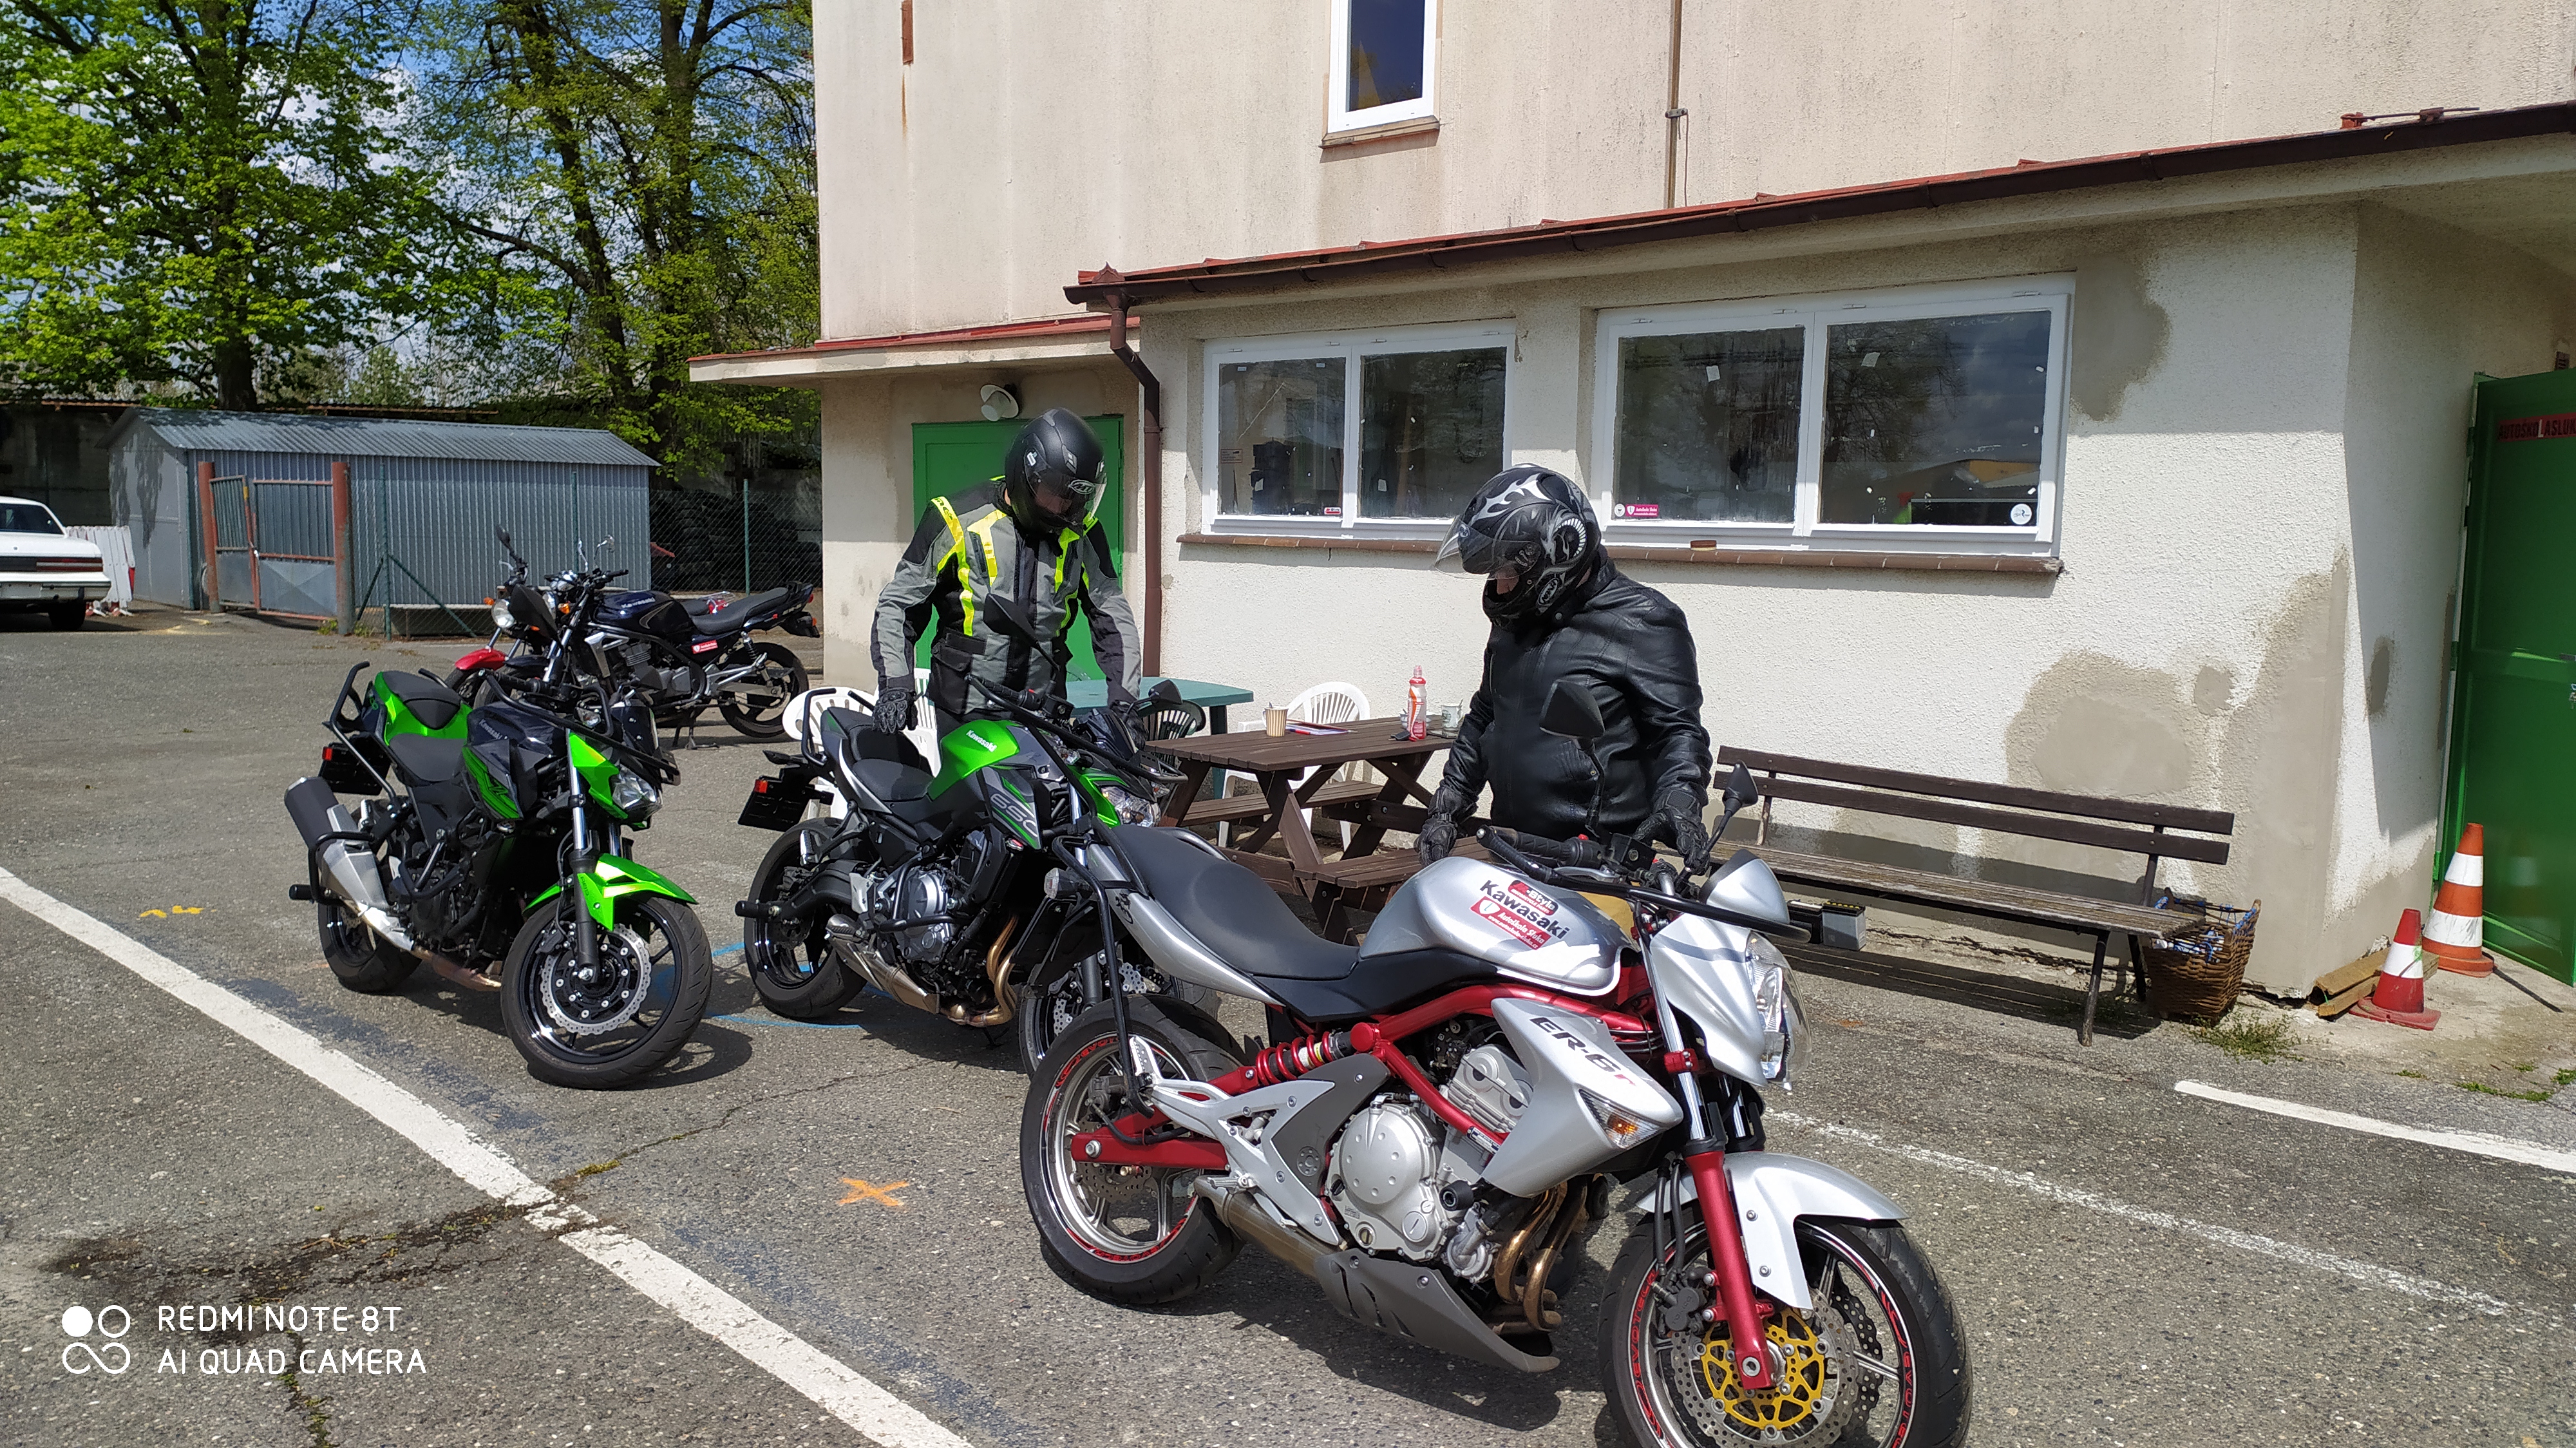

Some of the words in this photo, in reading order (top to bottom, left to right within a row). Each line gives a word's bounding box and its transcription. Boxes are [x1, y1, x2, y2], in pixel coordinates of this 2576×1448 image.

[965, 729, 998, 752] Kawasaki
[990, 793, 1039, 838] 650
[1479, 879, 1571, 940] Kawasaki
[1497, 911, 1528, 933] Autoškola
[1526, 928, 1545, 945] Sluka
